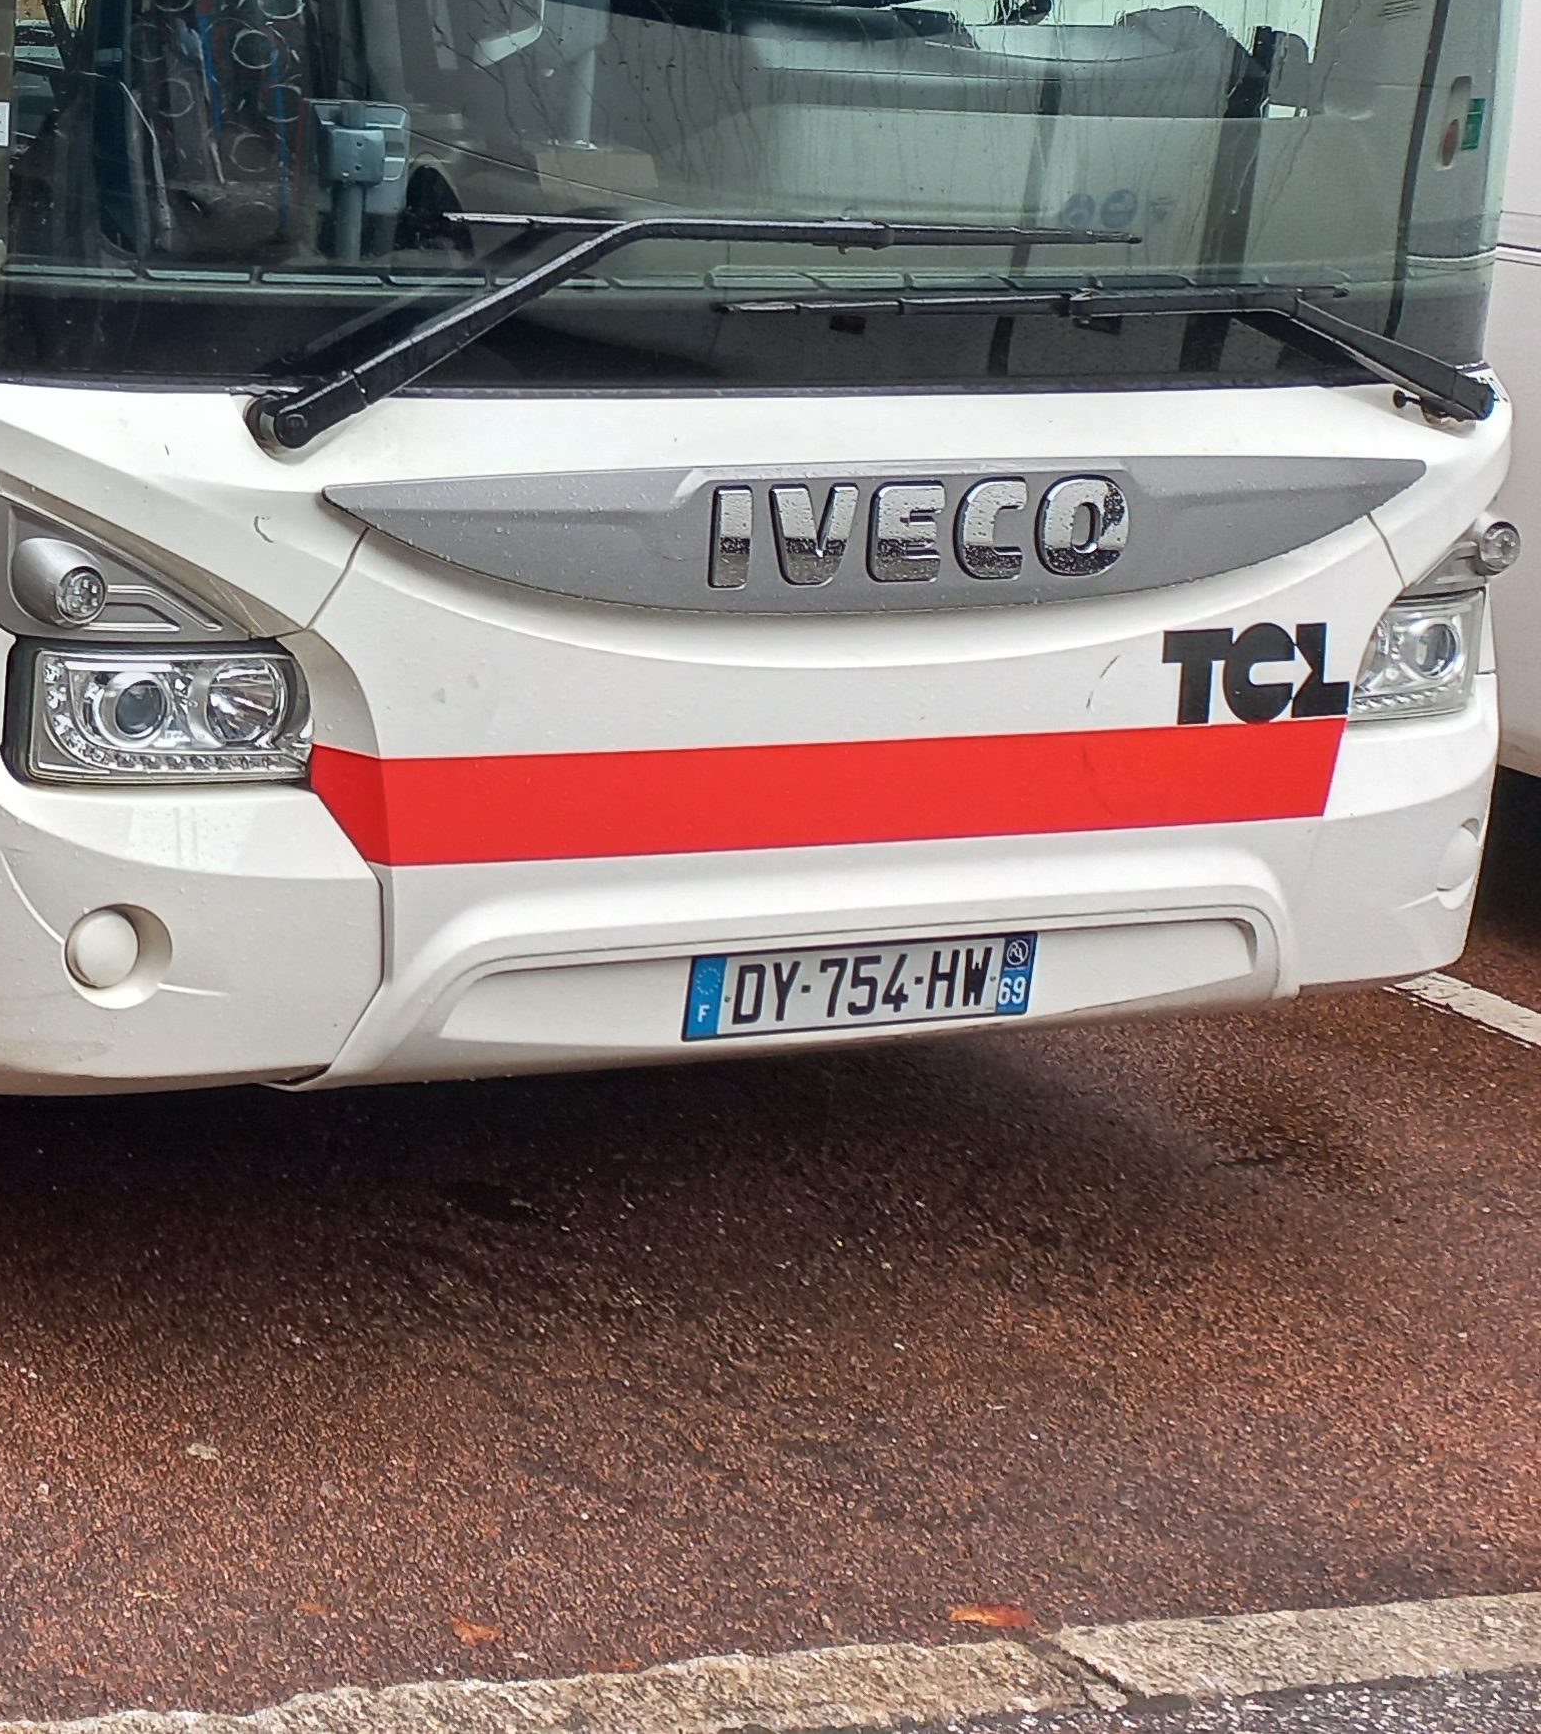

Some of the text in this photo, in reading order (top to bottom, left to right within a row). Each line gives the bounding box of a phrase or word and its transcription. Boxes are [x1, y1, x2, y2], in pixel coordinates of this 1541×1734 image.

[708, 474, 1131, 590] IVECO
[1162, 622, 1350, 725] TCL
[698, 946, 1026, 1026] F DY-754-HW 69
